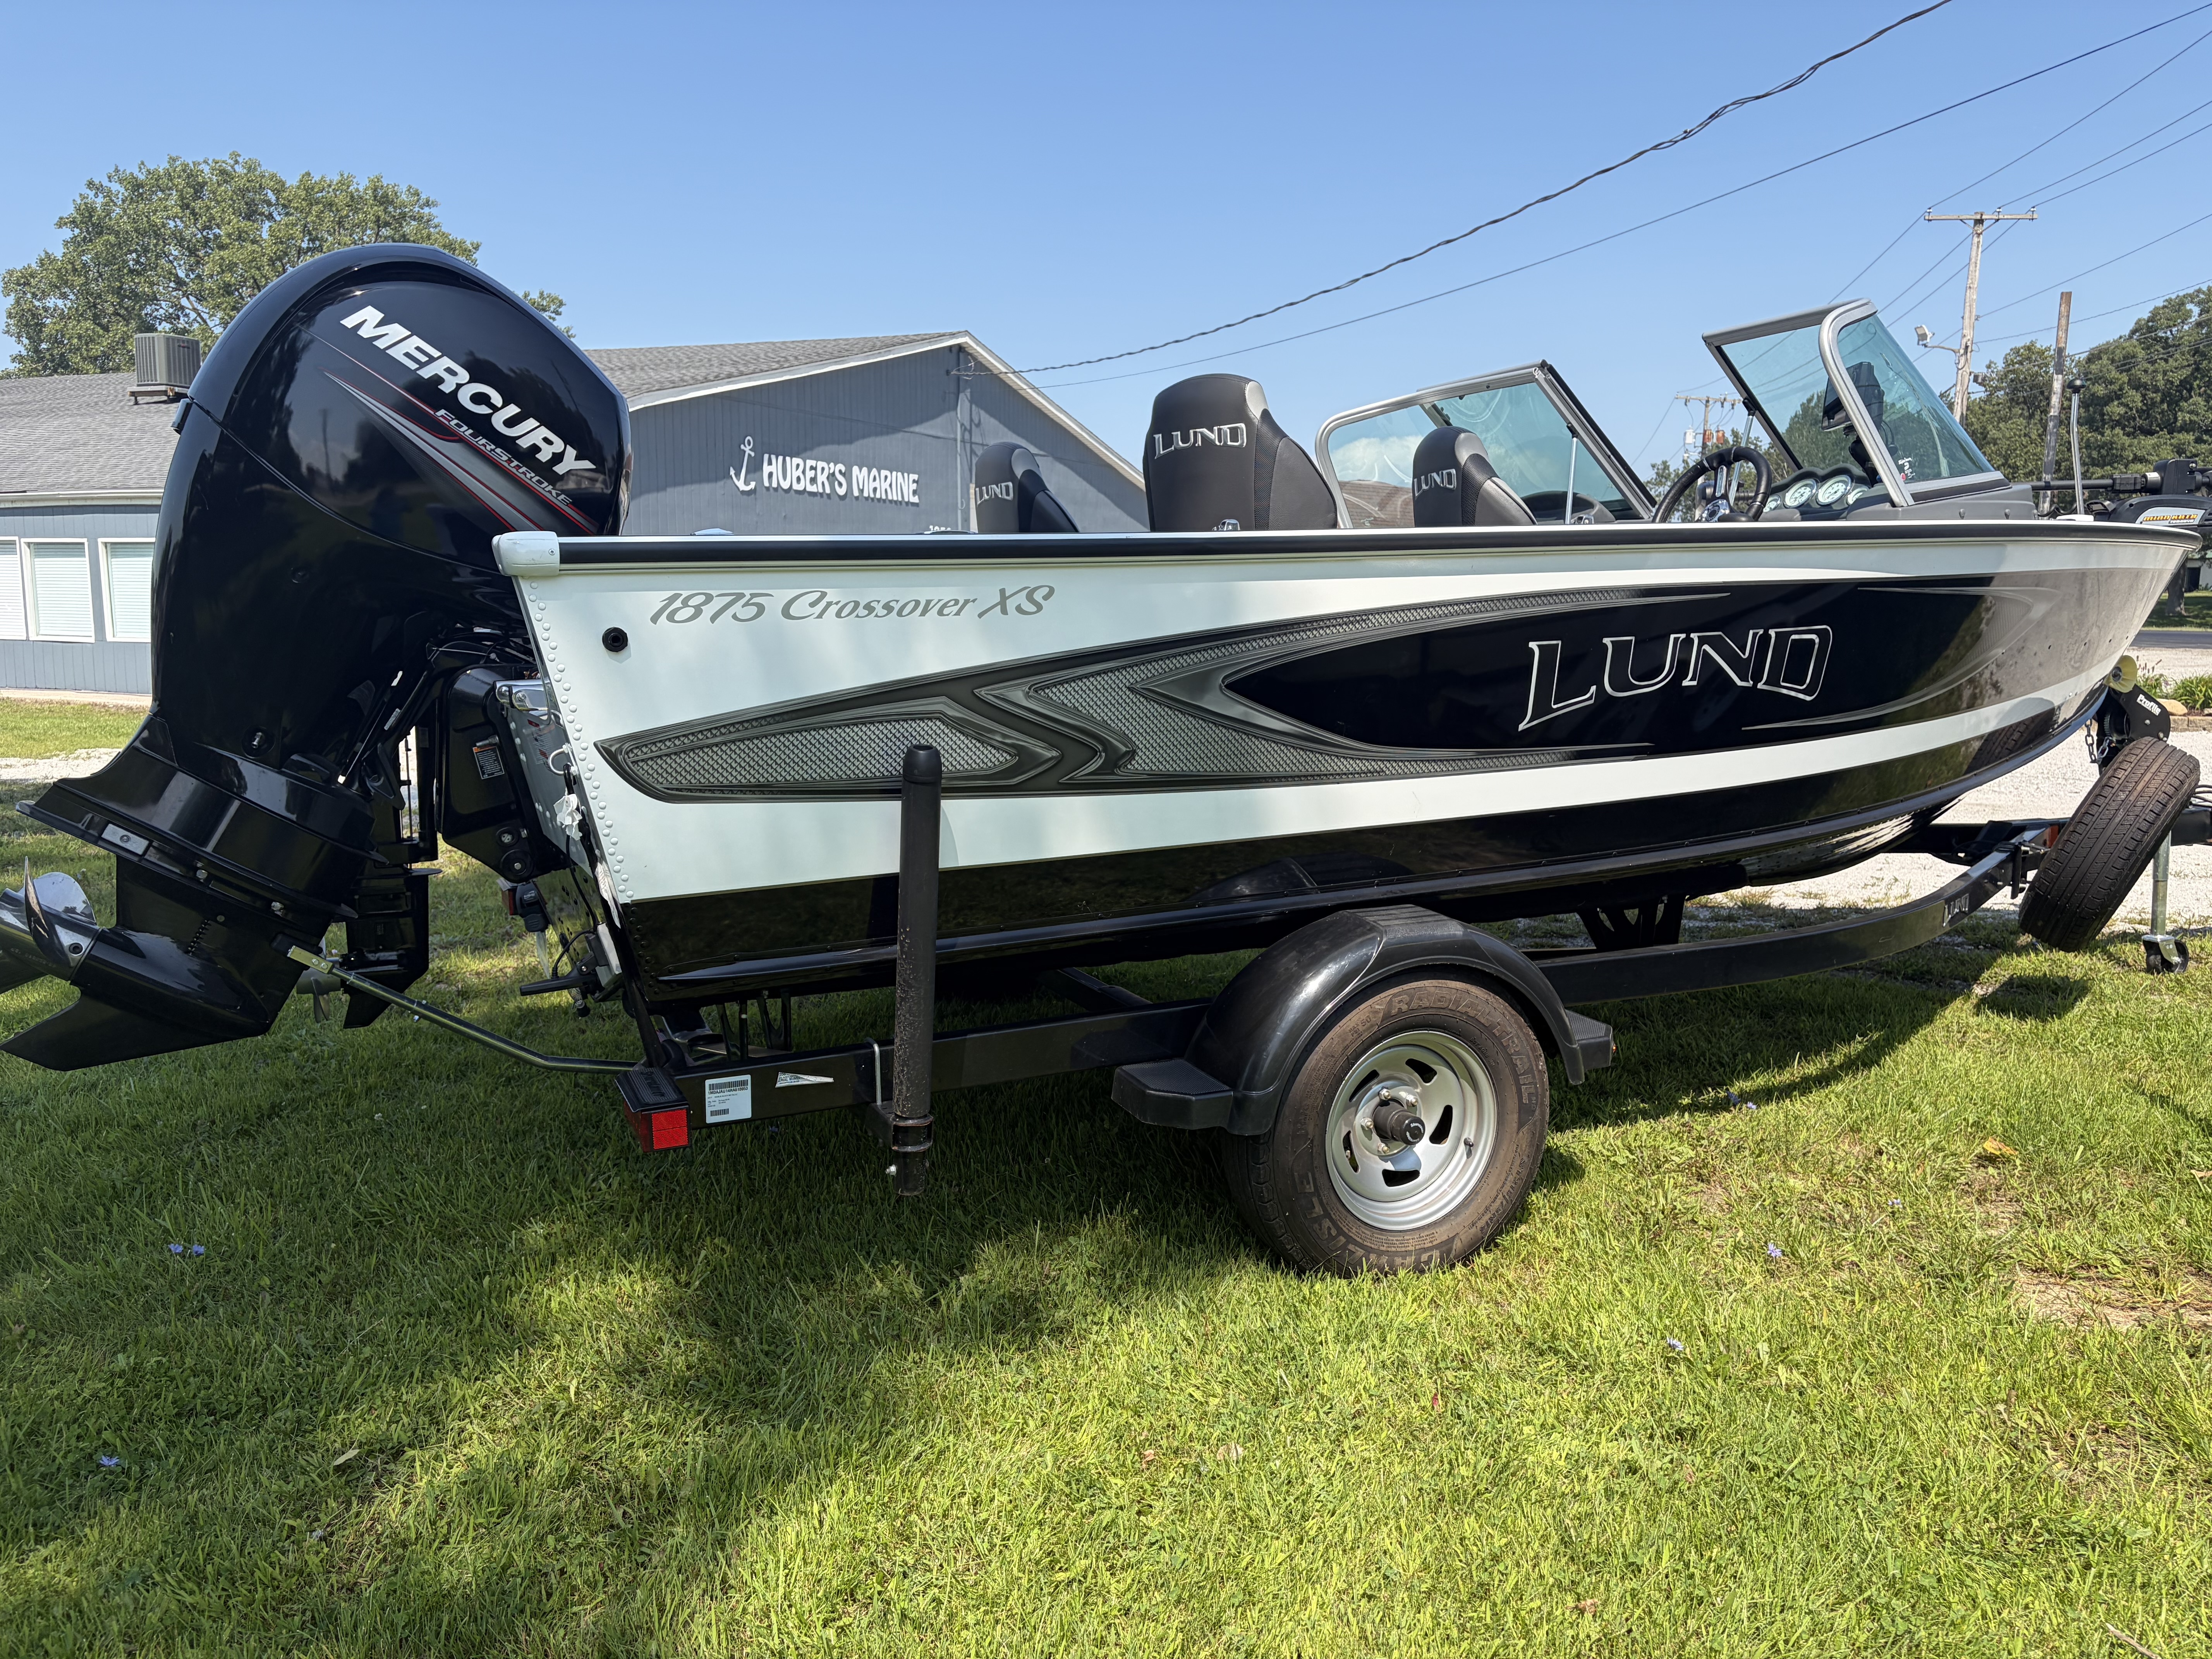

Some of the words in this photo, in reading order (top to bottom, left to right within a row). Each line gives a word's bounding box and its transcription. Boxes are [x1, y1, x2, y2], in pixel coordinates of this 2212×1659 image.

[340, 306, 596, 475] MERCURY
[434, 409, 571, 506] FOURSTROKE
[1153, 423, 1247, 459] LUND
[763, 453, 847, 496] HUBER'S
[852, 465, 919, 503] MARINE
[975, 481, 1013, 507] LUND
[1414, 468, 1456, 500] LUND
[650, 592, 775, 625] 1875
[781, 590, 977, 622] Crossover
[977, 585, 1055, 619] XS
[1518, 625, 1832, 732] LUND
[2136, 694, 2161, 713] Profile
[1390, 991, 1492, 1027] RADIAL
[1492, 1018, 1535, 1104] TRAIL
